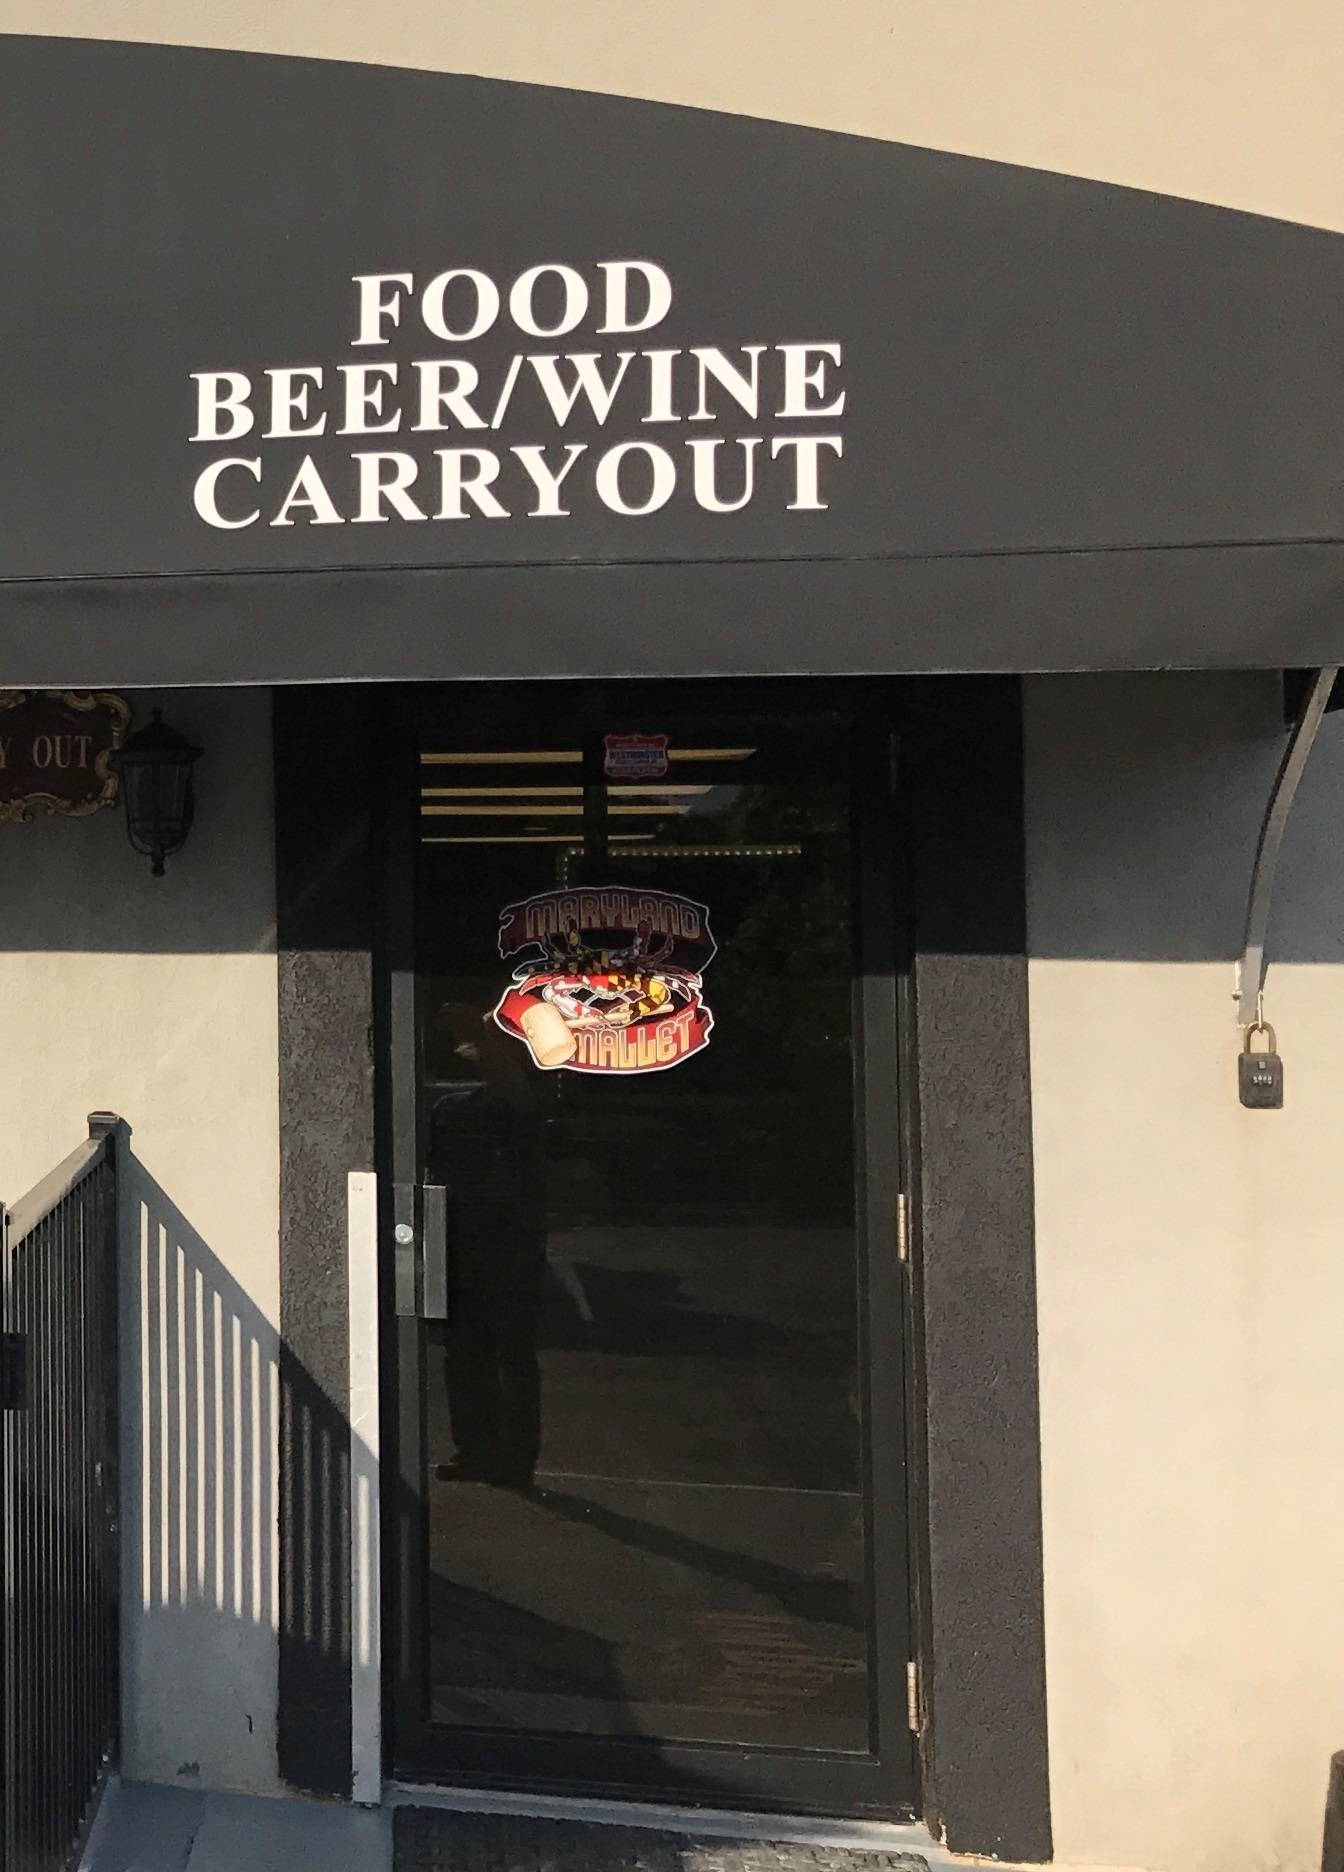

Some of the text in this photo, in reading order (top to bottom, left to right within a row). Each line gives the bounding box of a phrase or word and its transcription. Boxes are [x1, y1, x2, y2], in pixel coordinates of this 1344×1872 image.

[351, 260, 673, 346] FOOD
[188, 342, 846, 442] BEER/WINE
[192, 435, 844, 529] CARRYOUT
[32, 735, 93, 769] OUT
[525, 893, 701, 939] MARYLAND
[570, 1012, 697, 1069] MALLET
